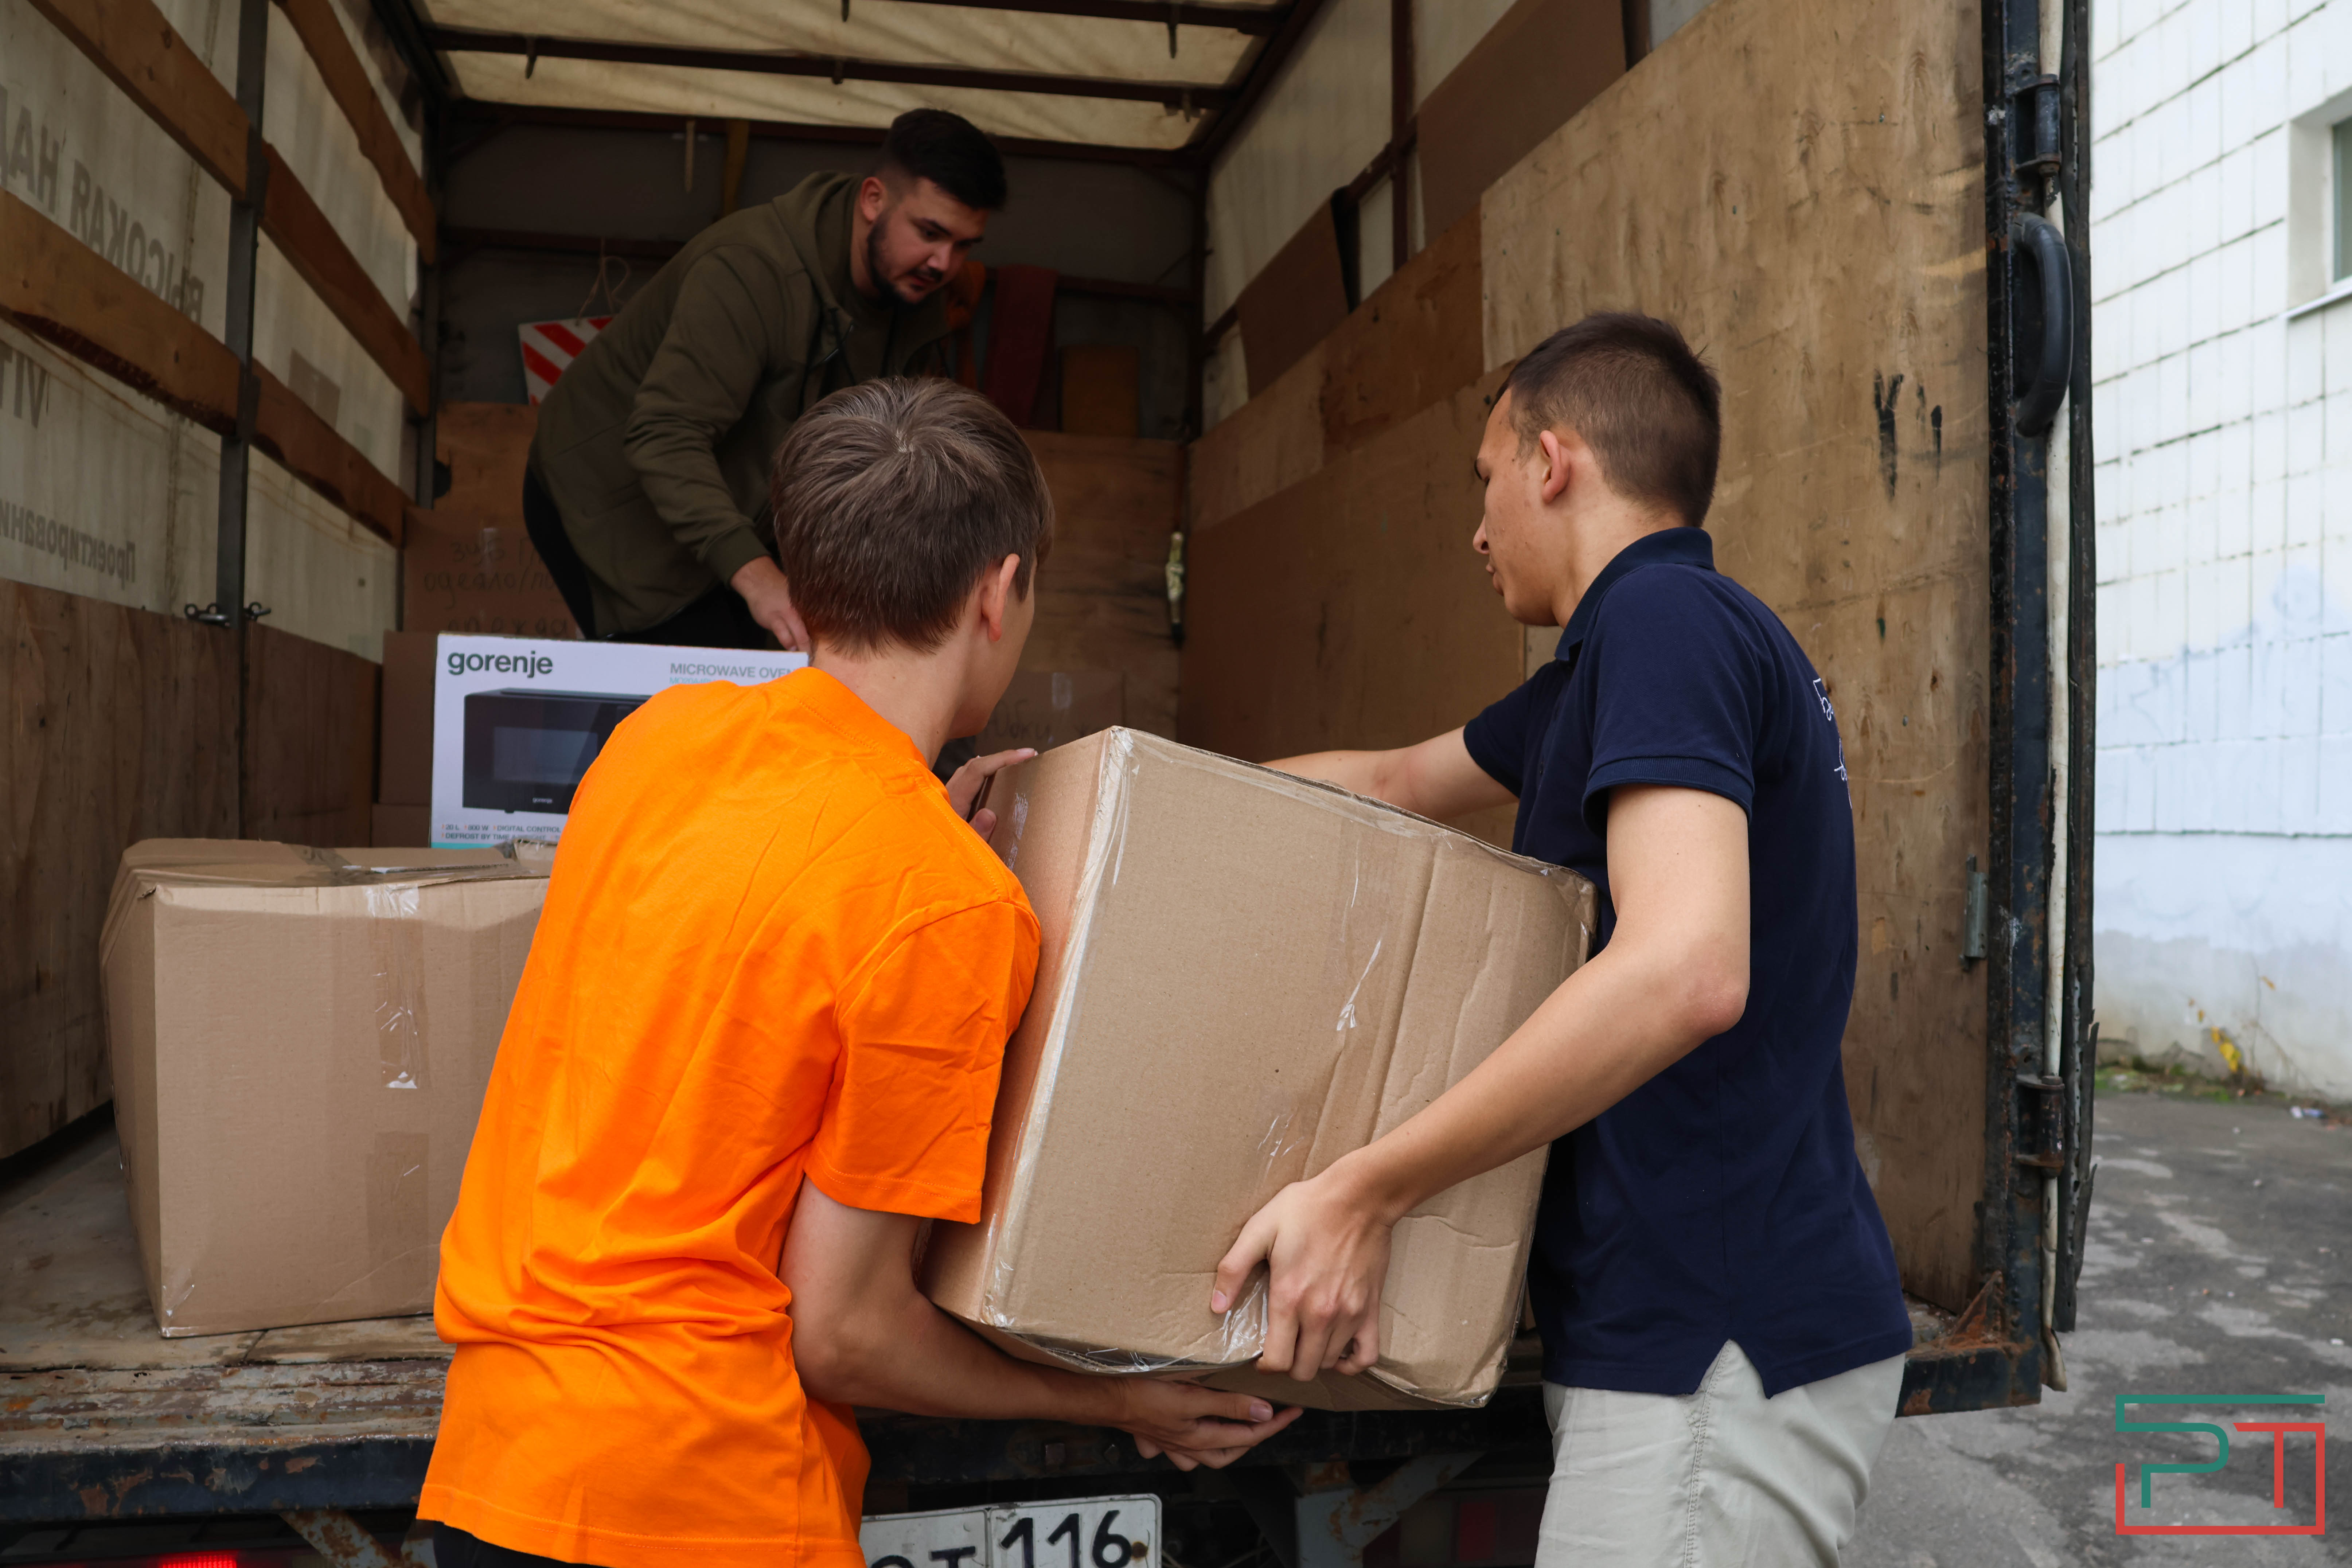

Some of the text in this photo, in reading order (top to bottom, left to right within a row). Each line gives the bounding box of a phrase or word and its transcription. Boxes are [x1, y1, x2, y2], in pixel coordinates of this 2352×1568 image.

[448, 650, 553, 678] gorenje
[670, 663, 756, 678] MICROWAVE
[999, 1510, 1133, 1568] 116
